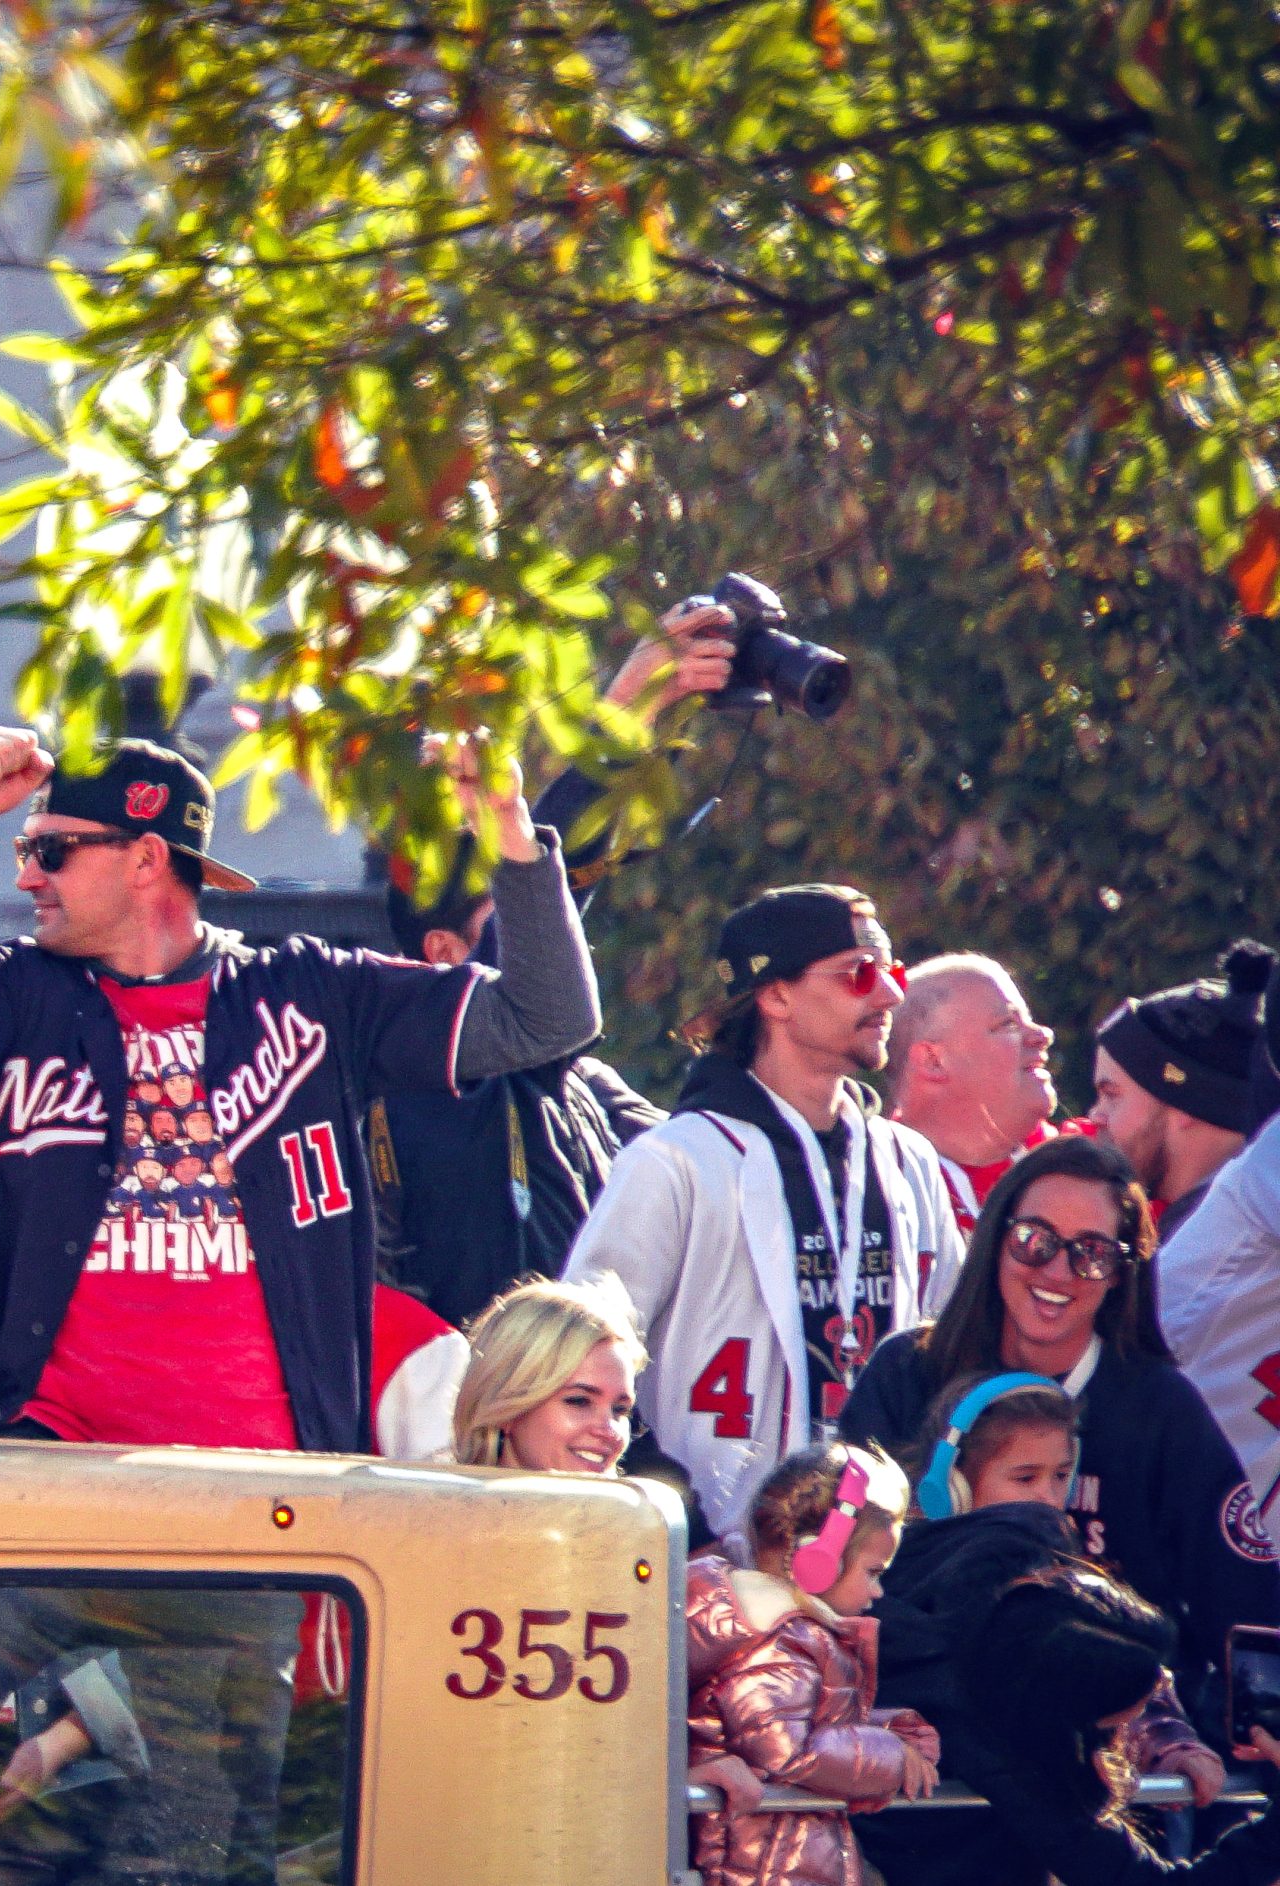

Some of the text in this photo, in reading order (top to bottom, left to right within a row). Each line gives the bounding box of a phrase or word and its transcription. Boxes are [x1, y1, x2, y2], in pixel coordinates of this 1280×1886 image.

[279, 1120, 352, 1228] 11
[688, 1336, 754, 1439] 4
[445, 1607, 630, 1704] 355
